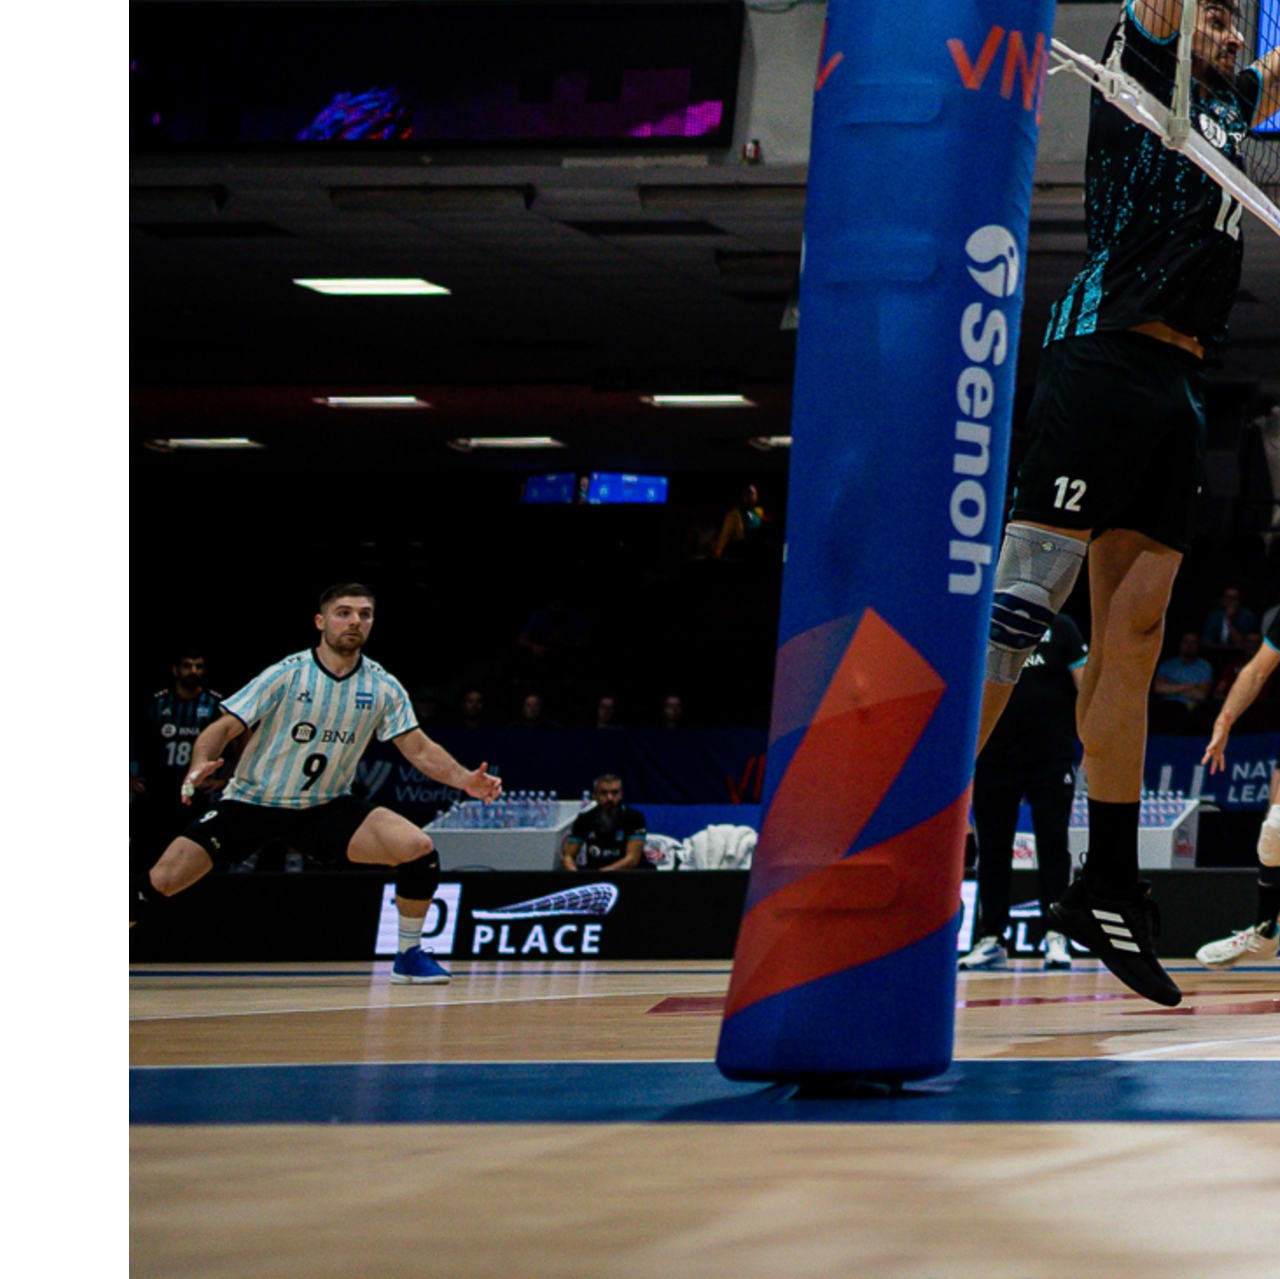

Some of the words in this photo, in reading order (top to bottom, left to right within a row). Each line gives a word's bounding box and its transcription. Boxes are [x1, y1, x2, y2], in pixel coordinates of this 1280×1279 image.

[947, 25, 1046, 114] VN
[947, 301, 1008, 597] Senoh
[1052, 475, 1087, 513] 12
[1022, 654, 1045, 668] NA
[165, 740, 192, 767] 18
[320, 729, 356, 745] BNA
[300, 753, 329, 793] 9
[472, 923, 602, 955] PLACE
